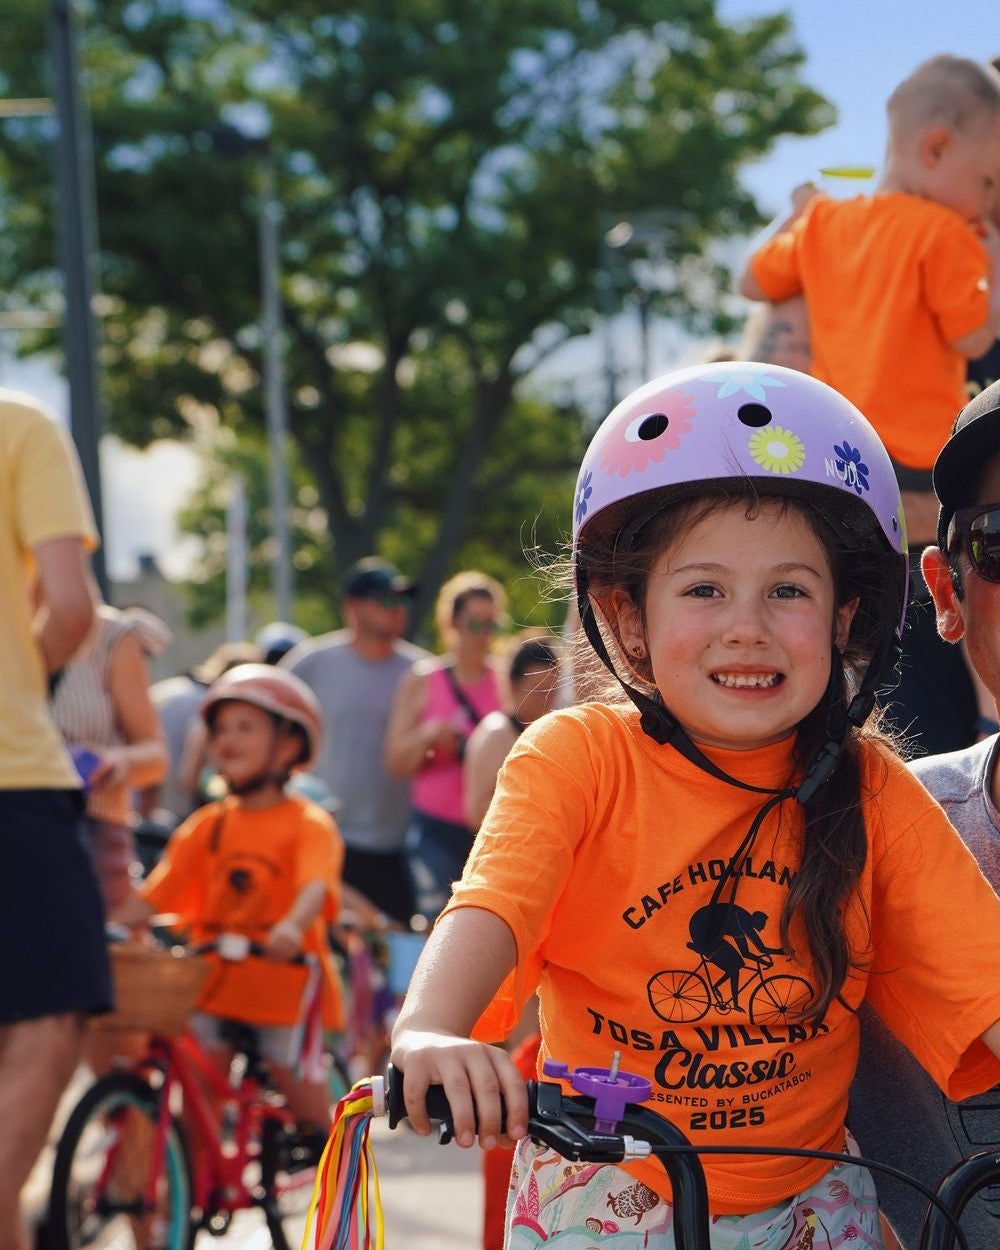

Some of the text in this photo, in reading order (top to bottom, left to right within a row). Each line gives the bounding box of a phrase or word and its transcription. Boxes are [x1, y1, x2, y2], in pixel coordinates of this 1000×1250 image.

[622, 857, 799, 929] CAFE HOLLAN
[587, 1007, 684, 1050] TOSA
[649, 1070, 812, 1108] ESENTED BY BUCKATABON
[654, 1048, 797, 1089] Classic
[690, 1106, 765, 1130] 2025
